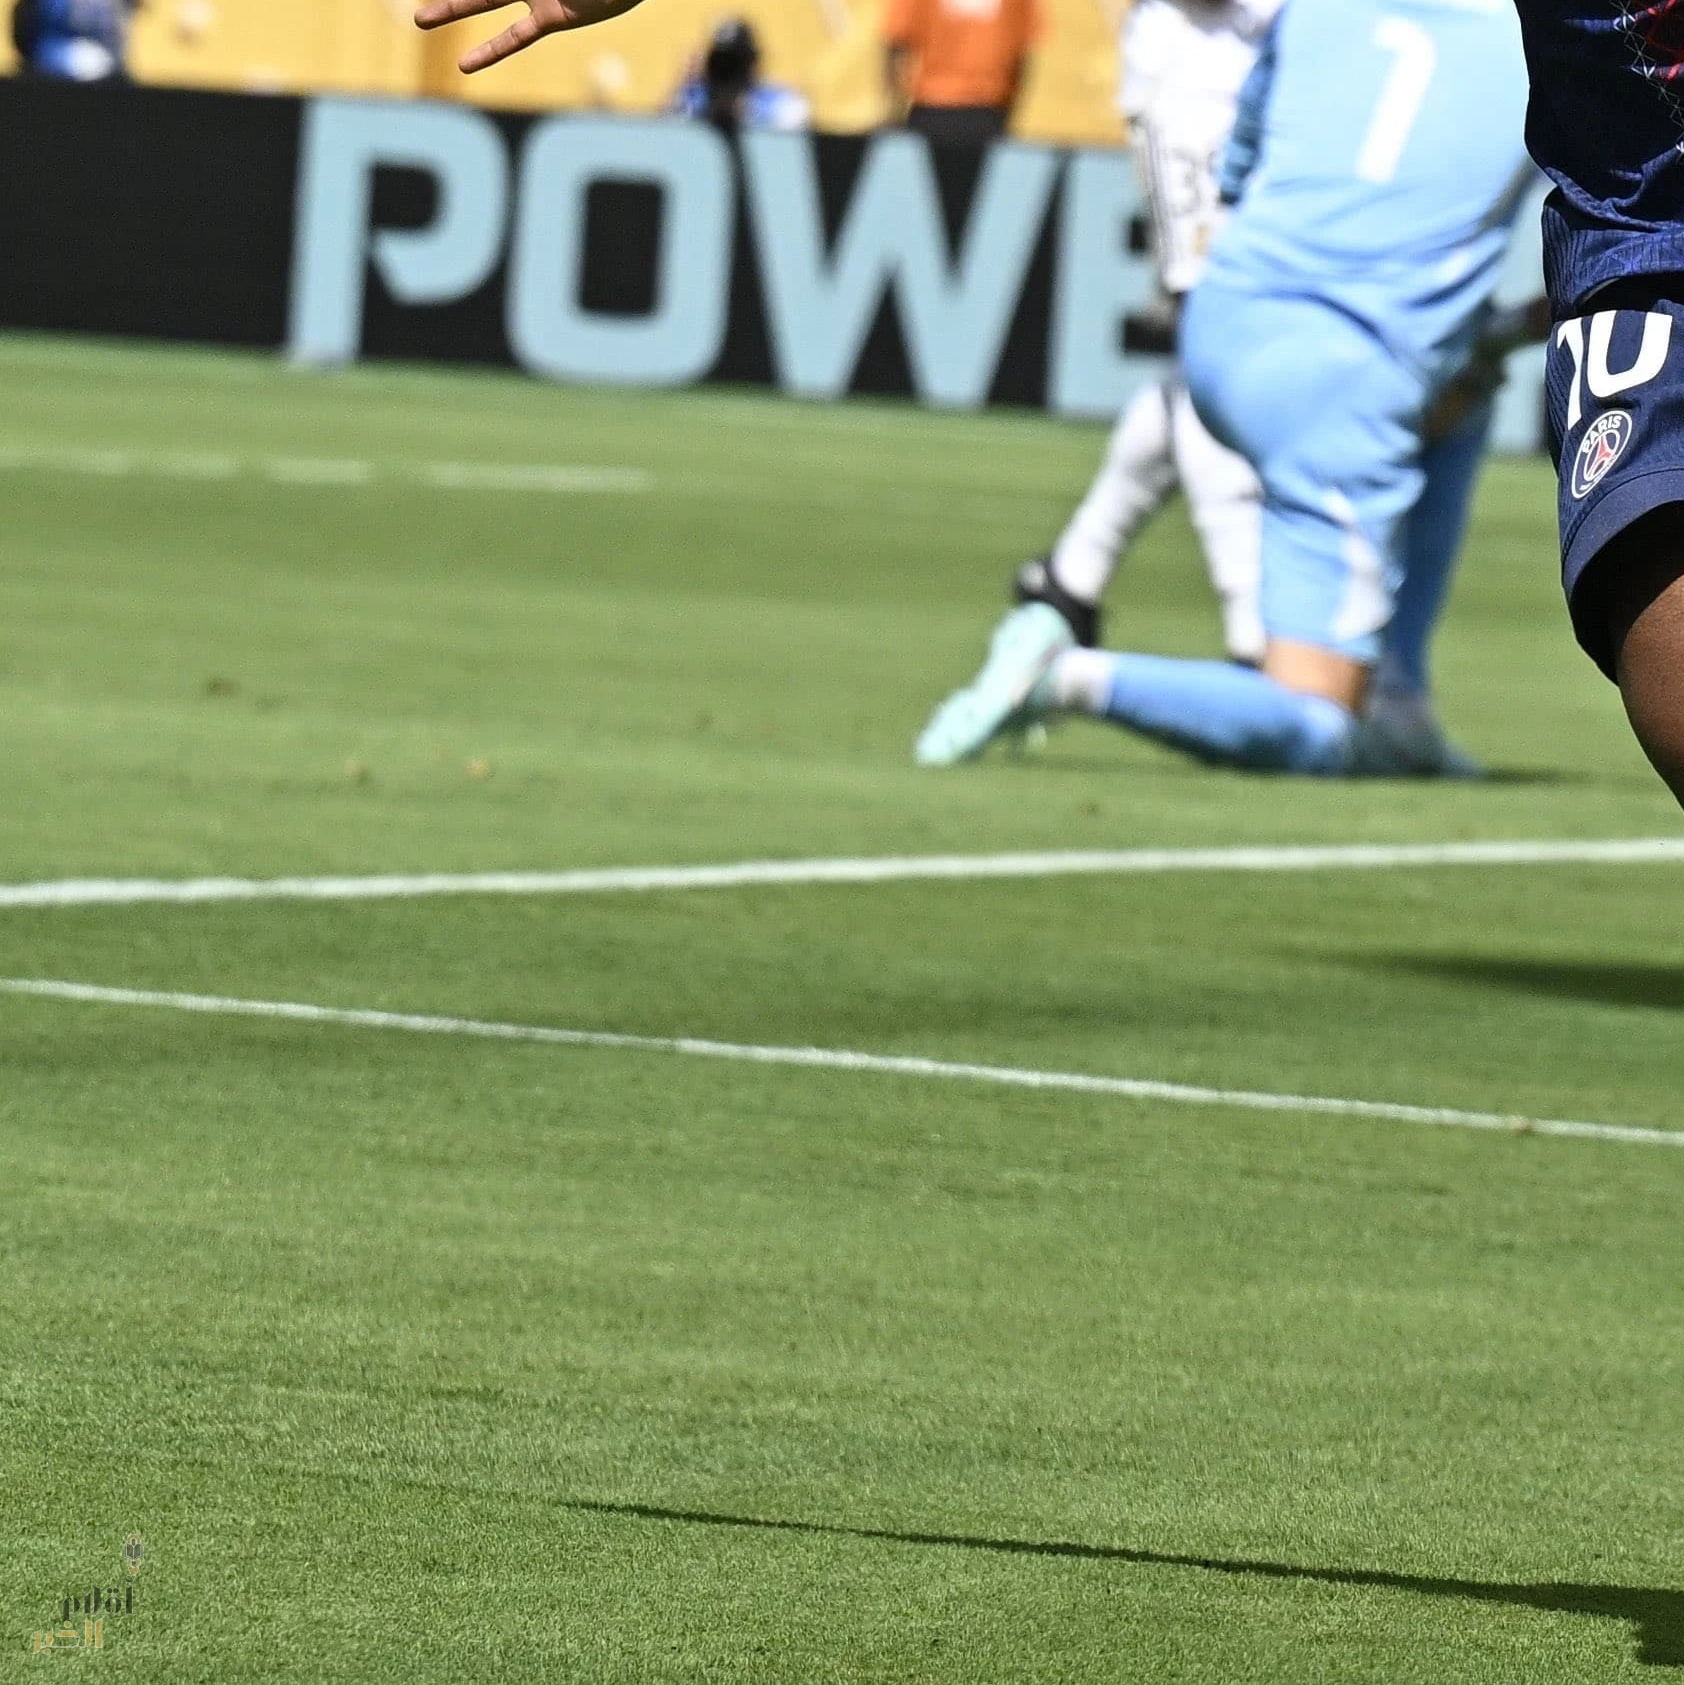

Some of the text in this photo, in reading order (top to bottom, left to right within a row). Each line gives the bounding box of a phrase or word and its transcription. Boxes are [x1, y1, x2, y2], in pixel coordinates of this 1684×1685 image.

[284, 92, 1192, 428] POWE
[1556, 309, 1674, 432] 10
[1582, 415, 1623, 454] PARIS
